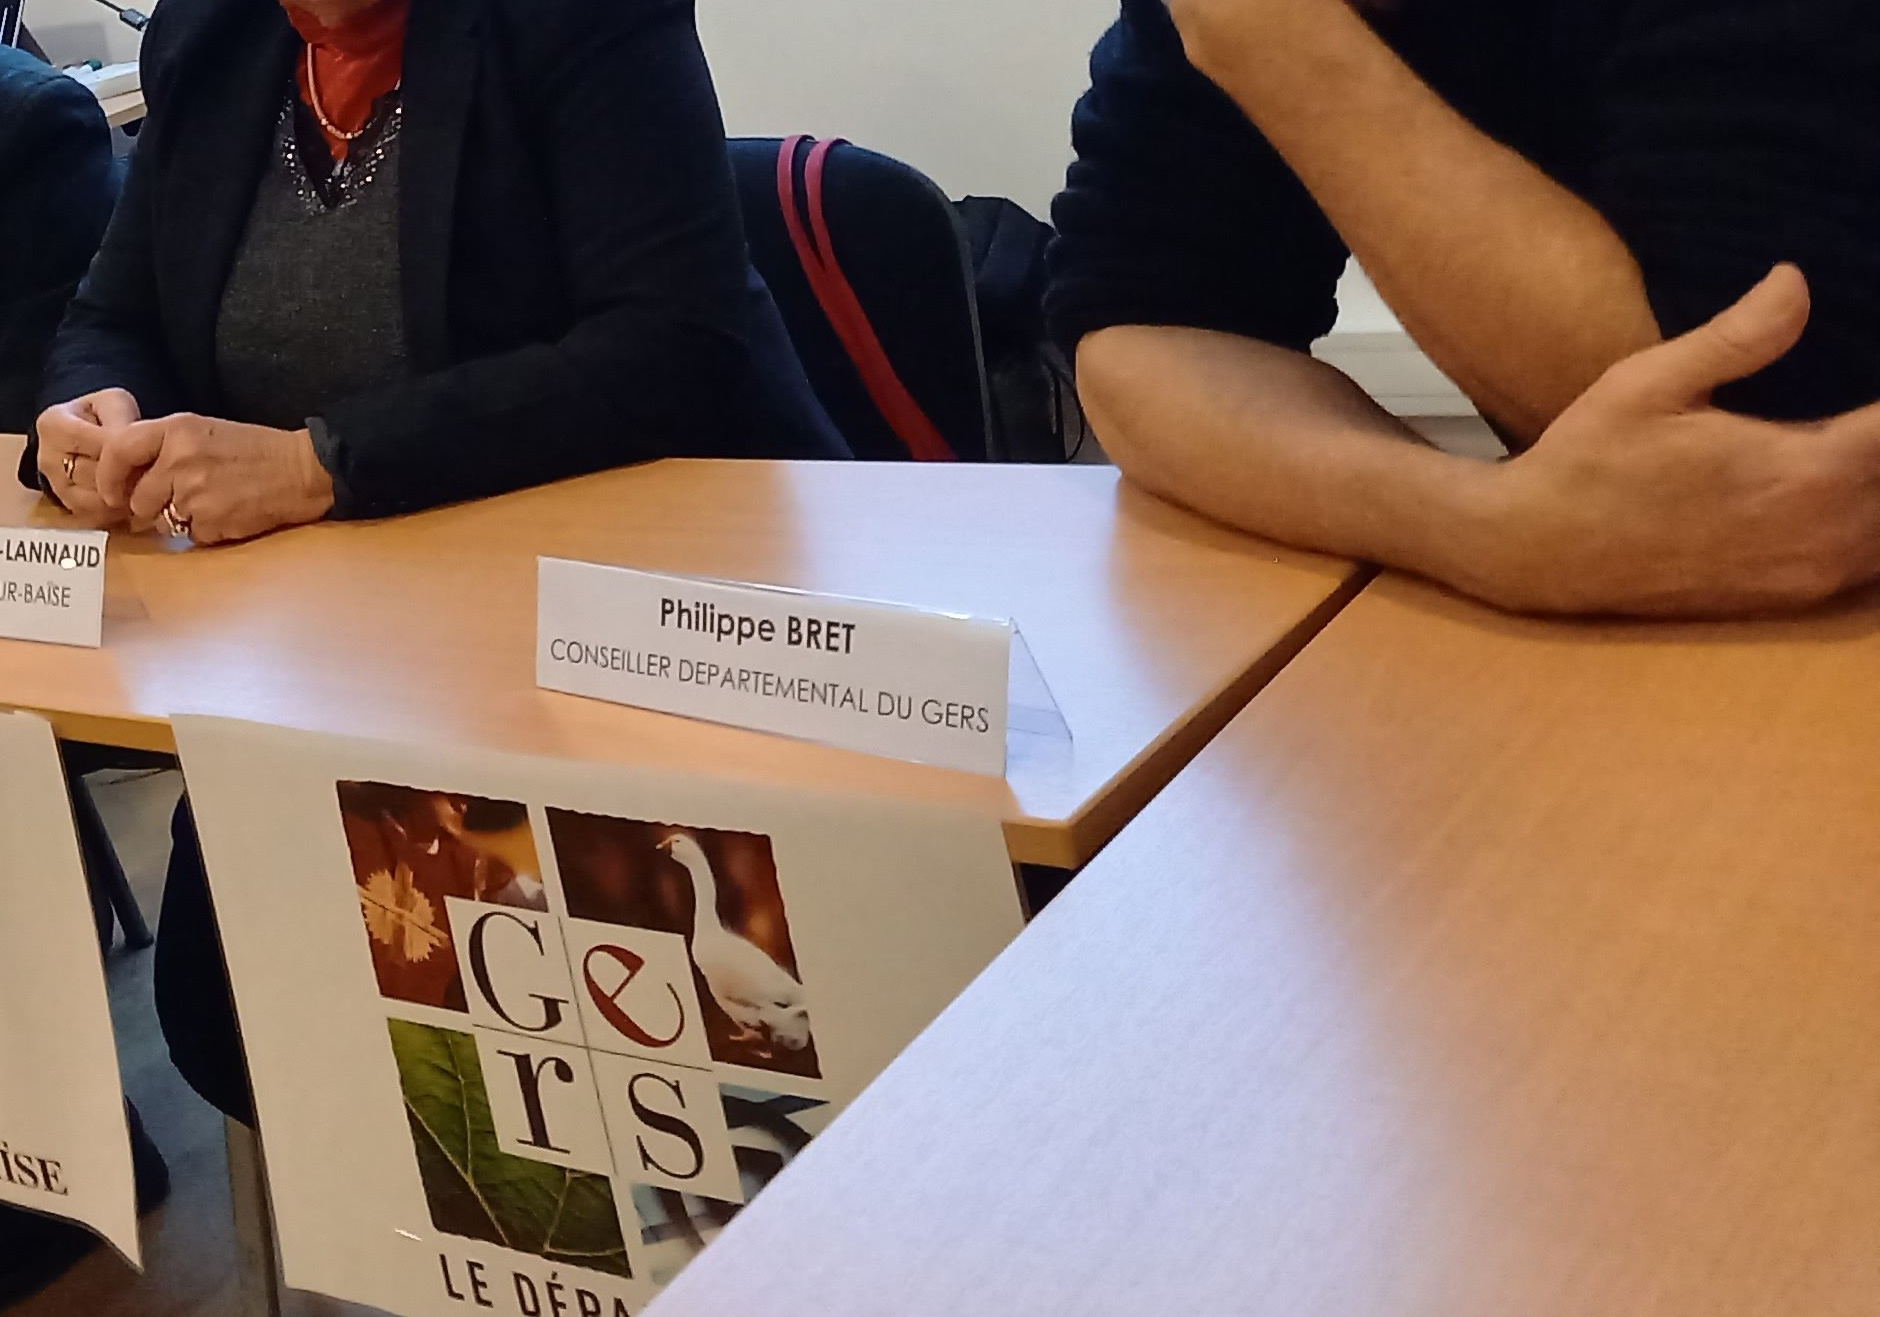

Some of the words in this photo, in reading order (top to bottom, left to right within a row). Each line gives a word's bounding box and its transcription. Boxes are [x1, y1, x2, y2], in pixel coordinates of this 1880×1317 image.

[659, 598, 776, 645] Philippe
[786, 615, 857, 655] BRET
[550, 638, 672, 680] CONSEILLER
[677, 658, 869, 714] DEPARTEMENTAL
[877, 691, 913, 720] DU
[920, 698, 990, 733] GERS
[438, 1253, 494, 1309] LE
